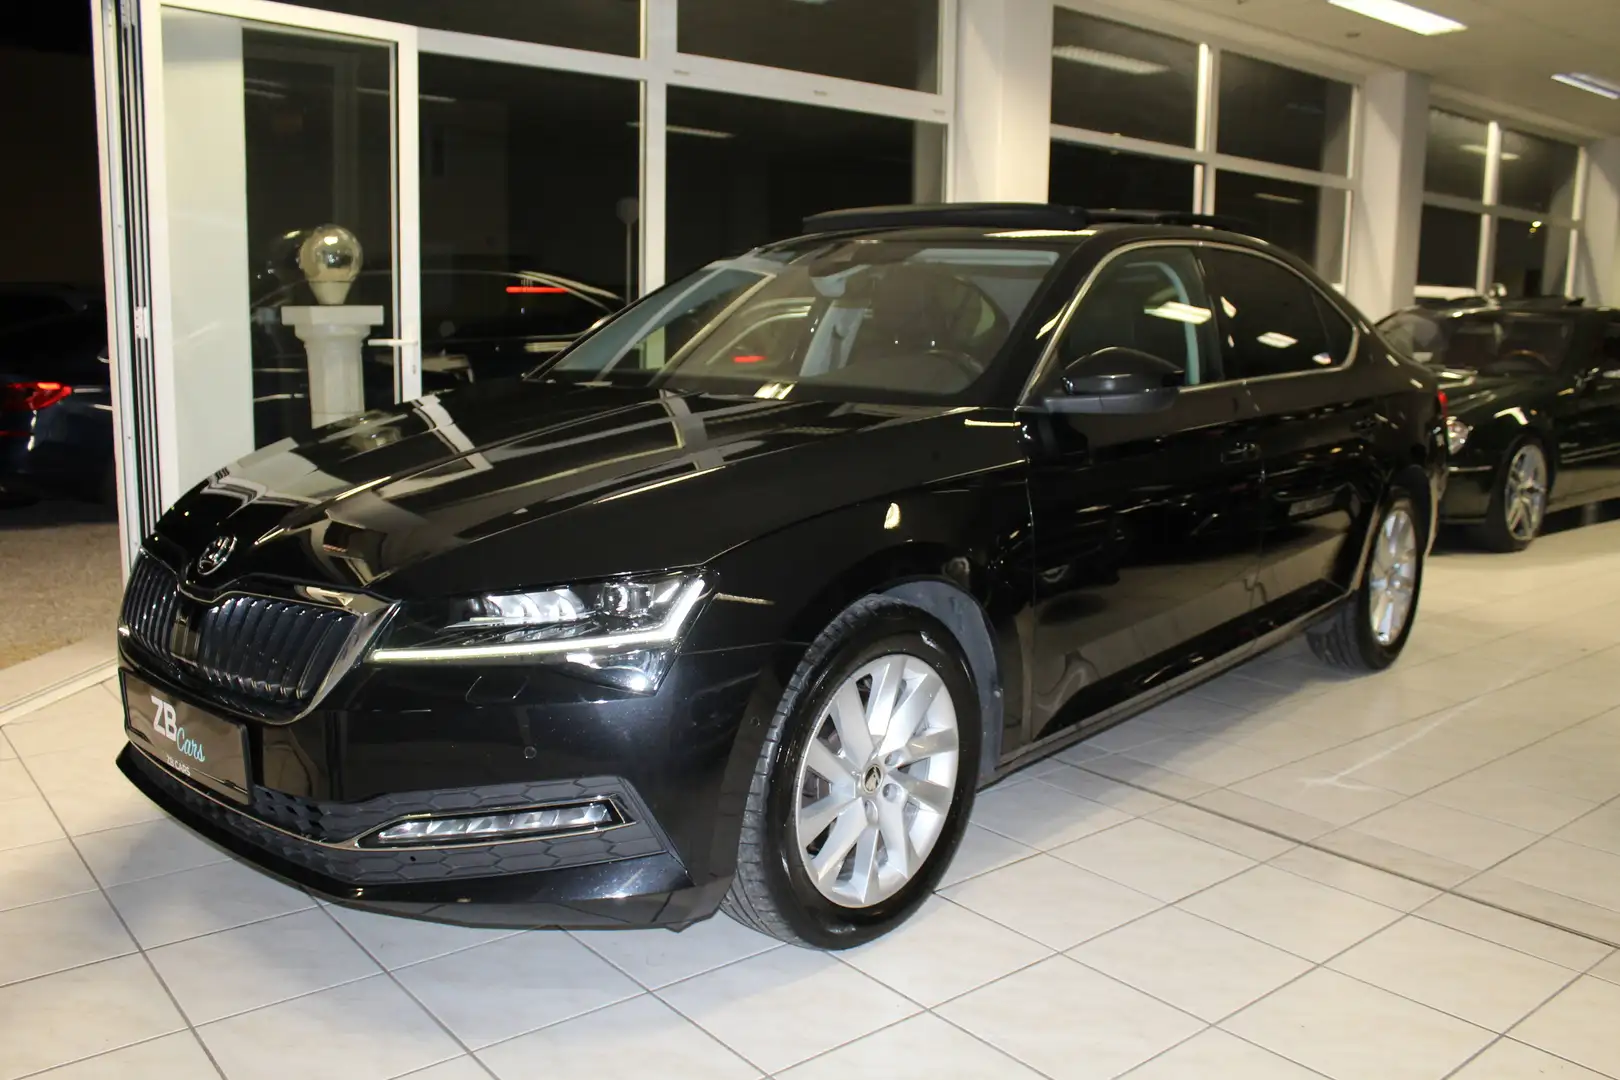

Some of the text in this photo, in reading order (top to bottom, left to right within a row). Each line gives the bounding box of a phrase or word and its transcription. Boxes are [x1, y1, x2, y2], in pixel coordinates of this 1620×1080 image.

[150, 695, 205, 763] ZB Cars
[174, 760, 191, 776] CARS
